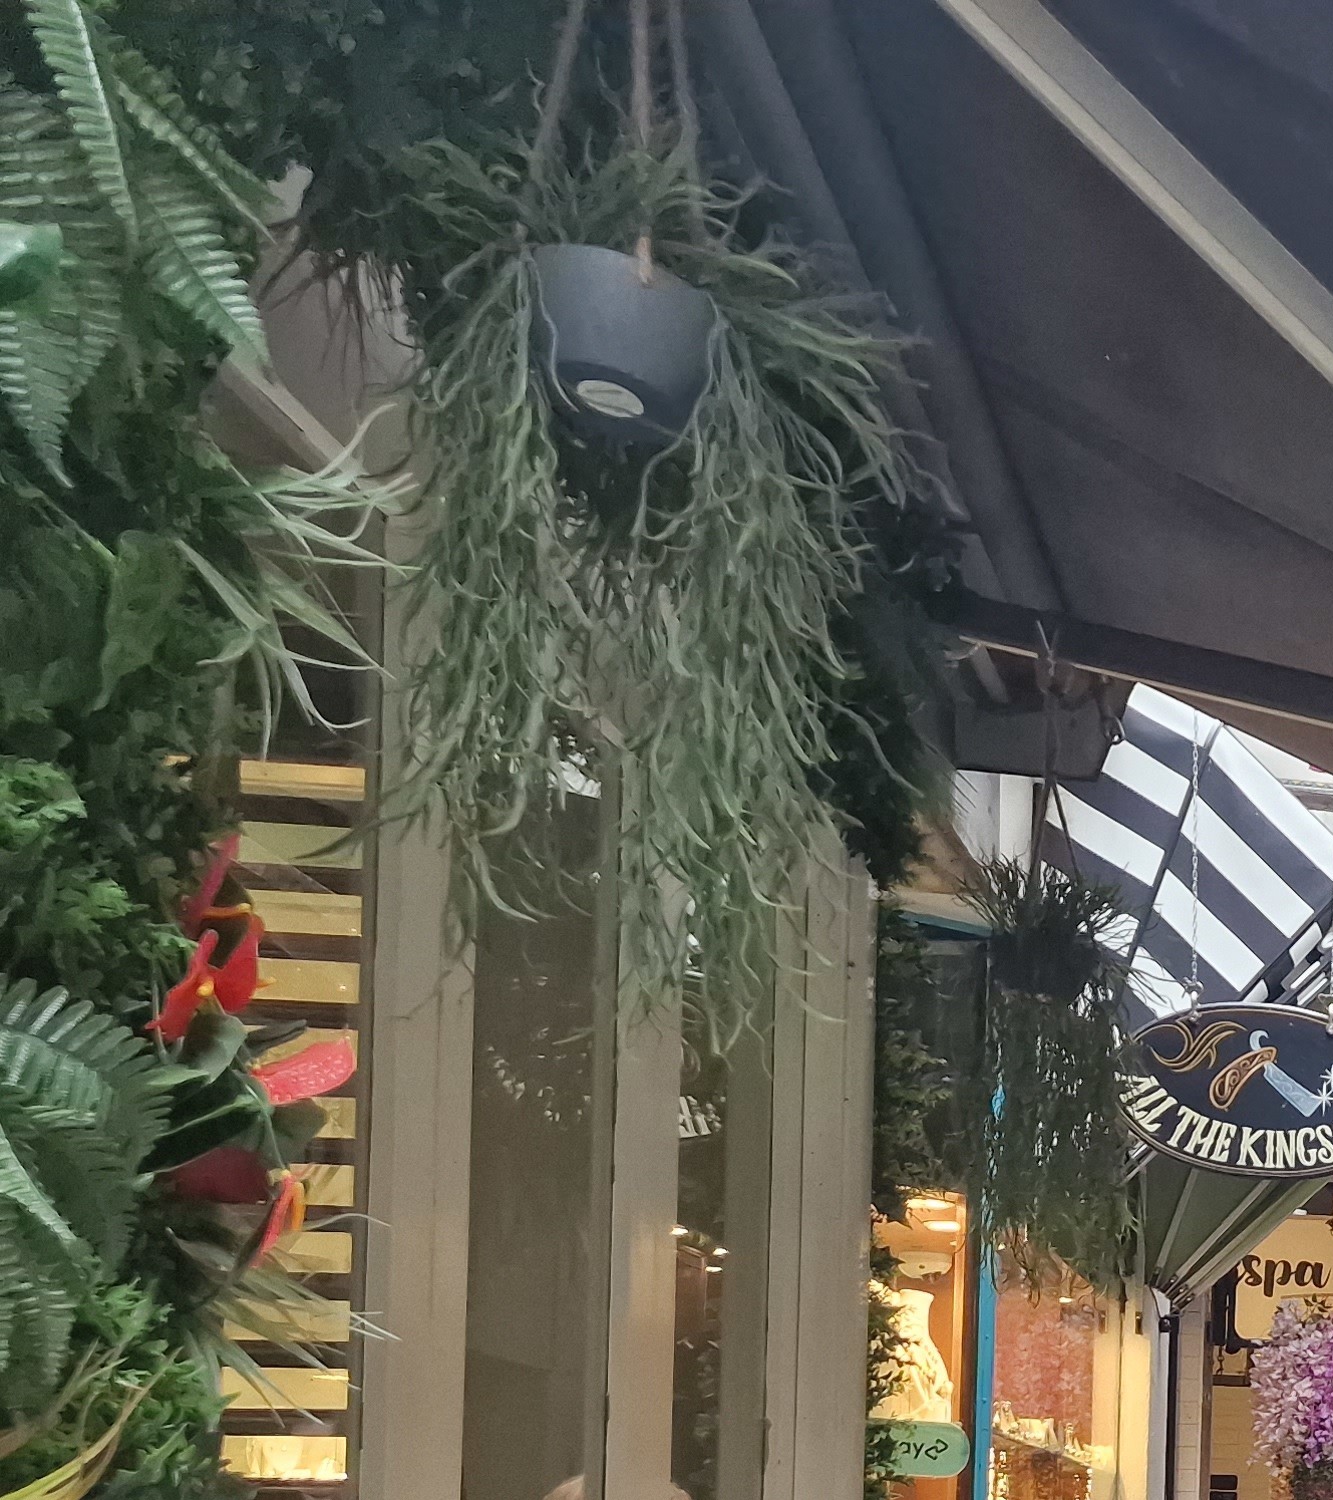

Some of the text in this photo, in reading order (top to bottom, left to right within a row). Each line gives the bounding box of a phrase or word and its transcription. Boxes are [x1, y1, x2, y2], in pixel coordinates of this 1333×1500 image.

[1114, 1072, 1178, 1132] ALL
[1167, 1105, 1236, 1162] THE
[1236, 1254, 1331, 1297] spa
